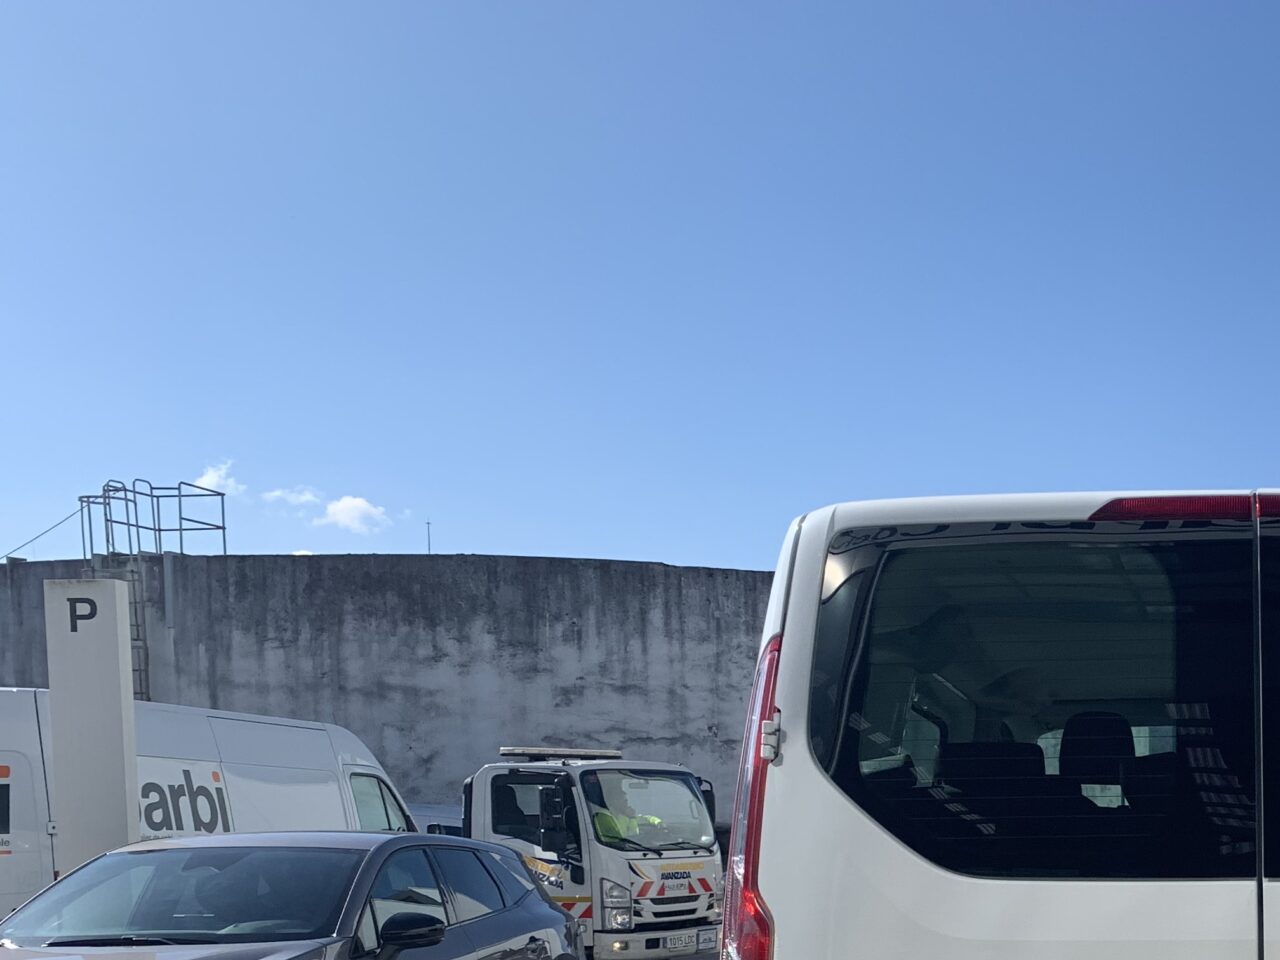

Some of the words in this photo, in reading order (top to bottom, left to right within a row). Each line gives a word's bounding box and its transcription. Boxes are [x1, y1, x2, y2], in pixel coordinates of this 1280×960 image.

[66, 597, 98, 633] P
[139, 769, 231, 834] arbi
[660, 871, 692, 880] AVANZADA
